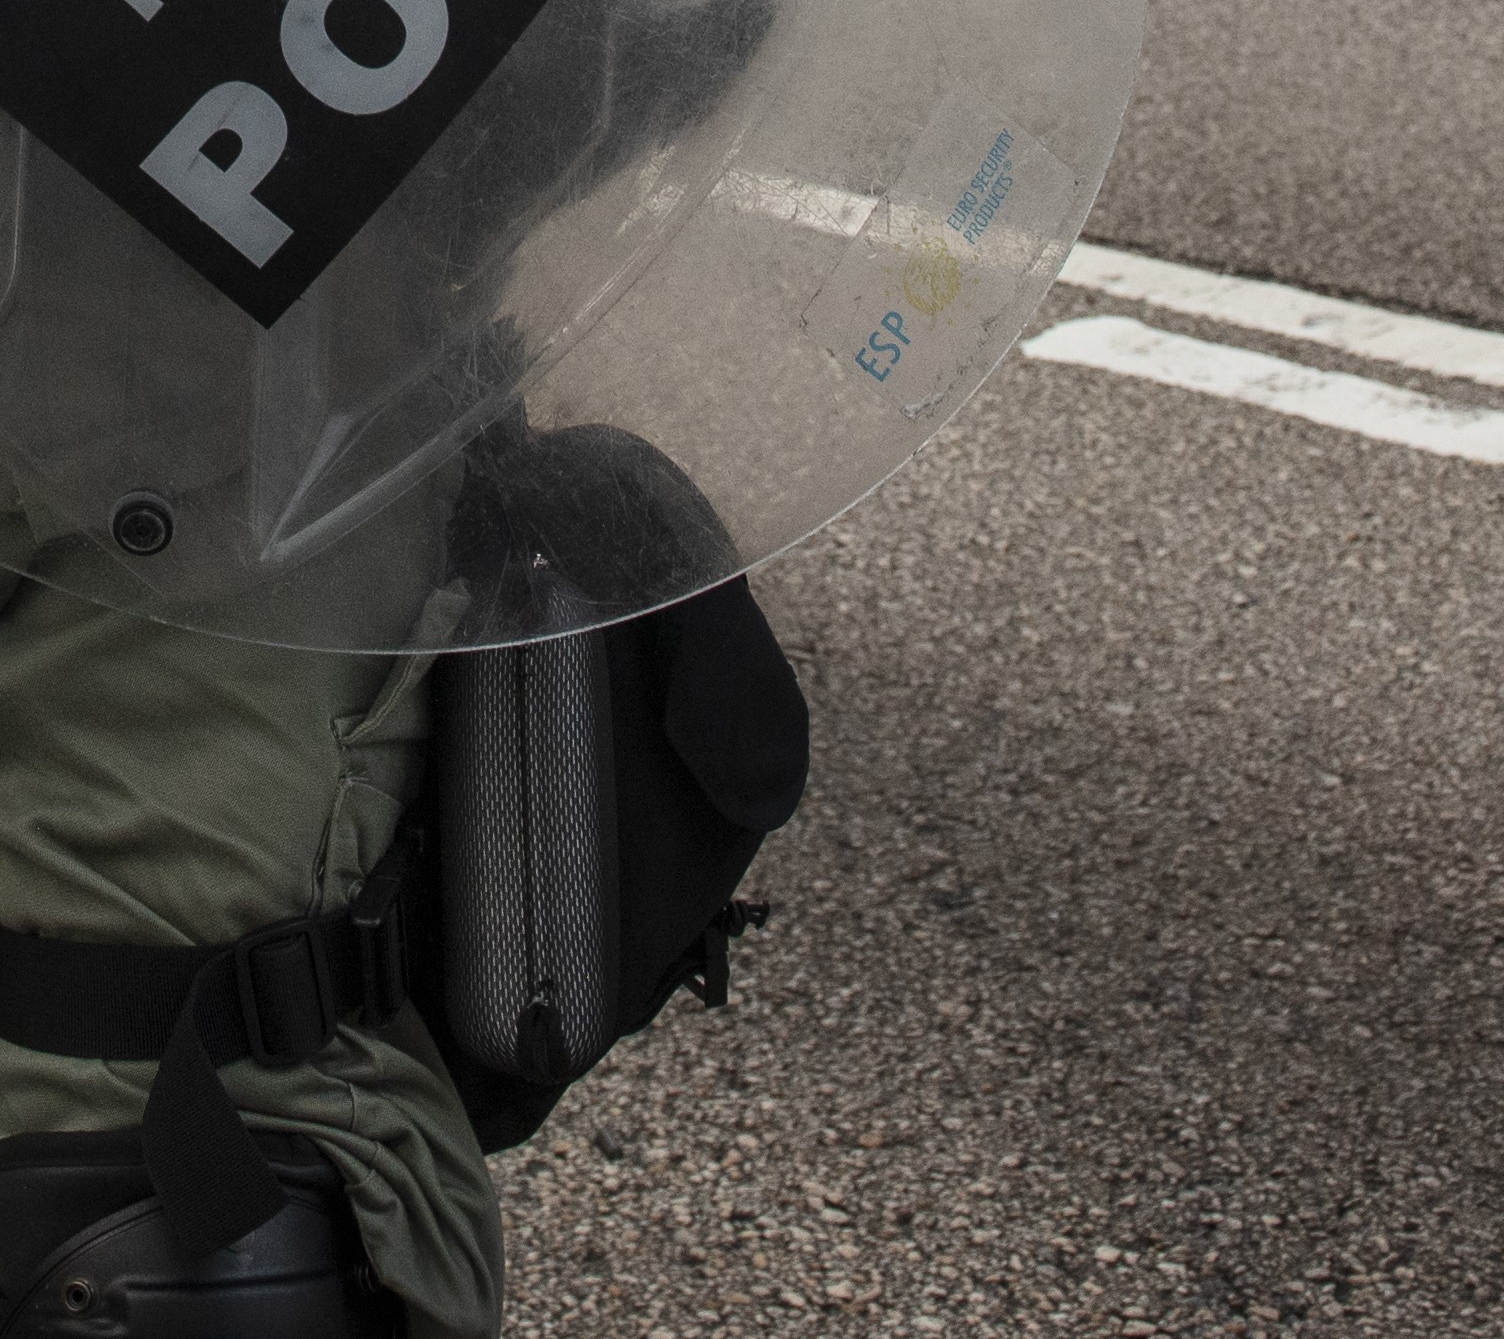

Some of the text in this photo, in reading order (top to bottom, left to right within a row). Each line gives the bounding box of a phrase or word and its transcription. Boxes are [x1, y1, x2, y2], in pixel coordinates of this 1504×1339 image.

[946, 127, 1015, 233] EURO SECURITY
[855, 310, 911, 383] ESP
